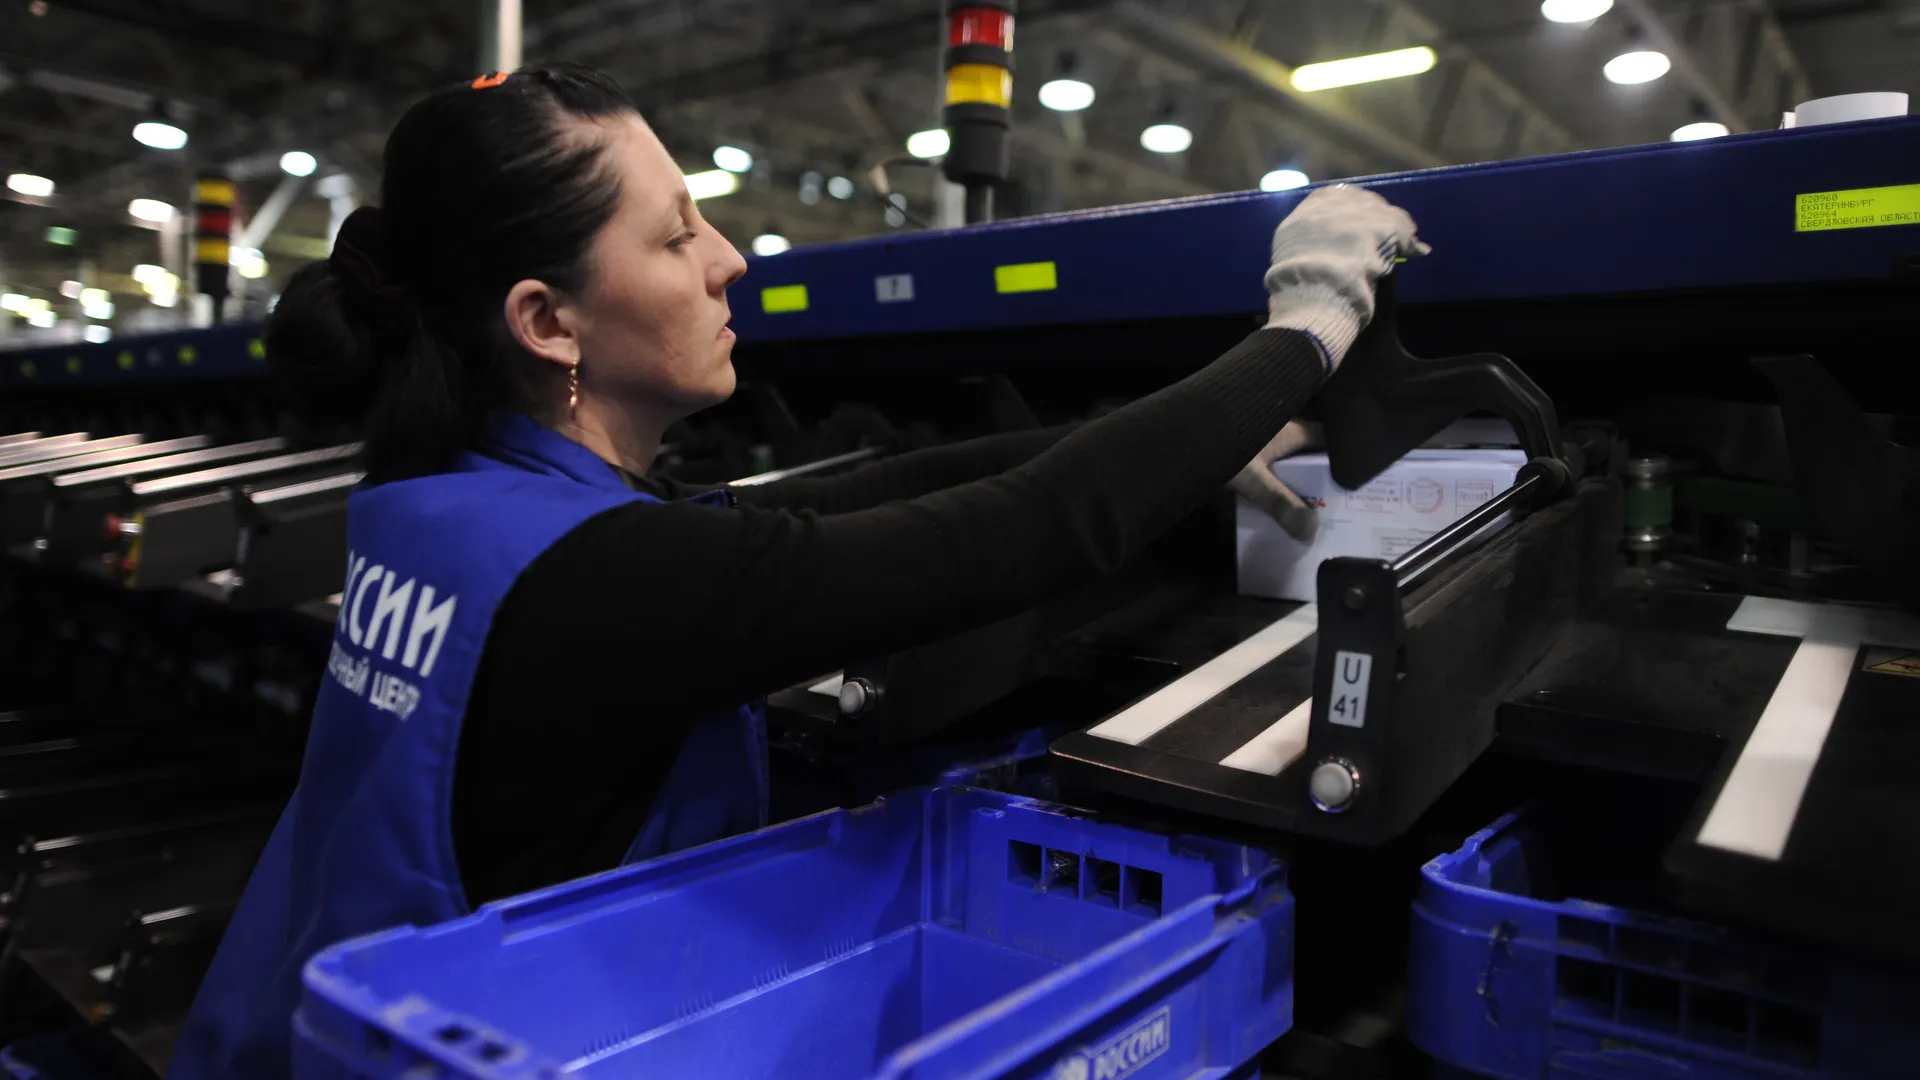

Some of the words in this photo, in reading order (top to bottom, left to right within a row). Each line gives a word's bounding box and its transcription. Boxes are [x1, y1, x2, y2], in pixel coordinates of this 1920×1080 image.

[1801, 199, 1875, 212] ЕКАТЕРИНБУРГ
[1801, 215, 1875, 228] СВЕРДЛОВСКАЯ
[1880, 211, 1920, 223] ОБЛАСТ
[340, 550, 458, 679] ССИИ
[1343, 657, 1362, 685] U
[1333, 694, 1359, 719] 41
